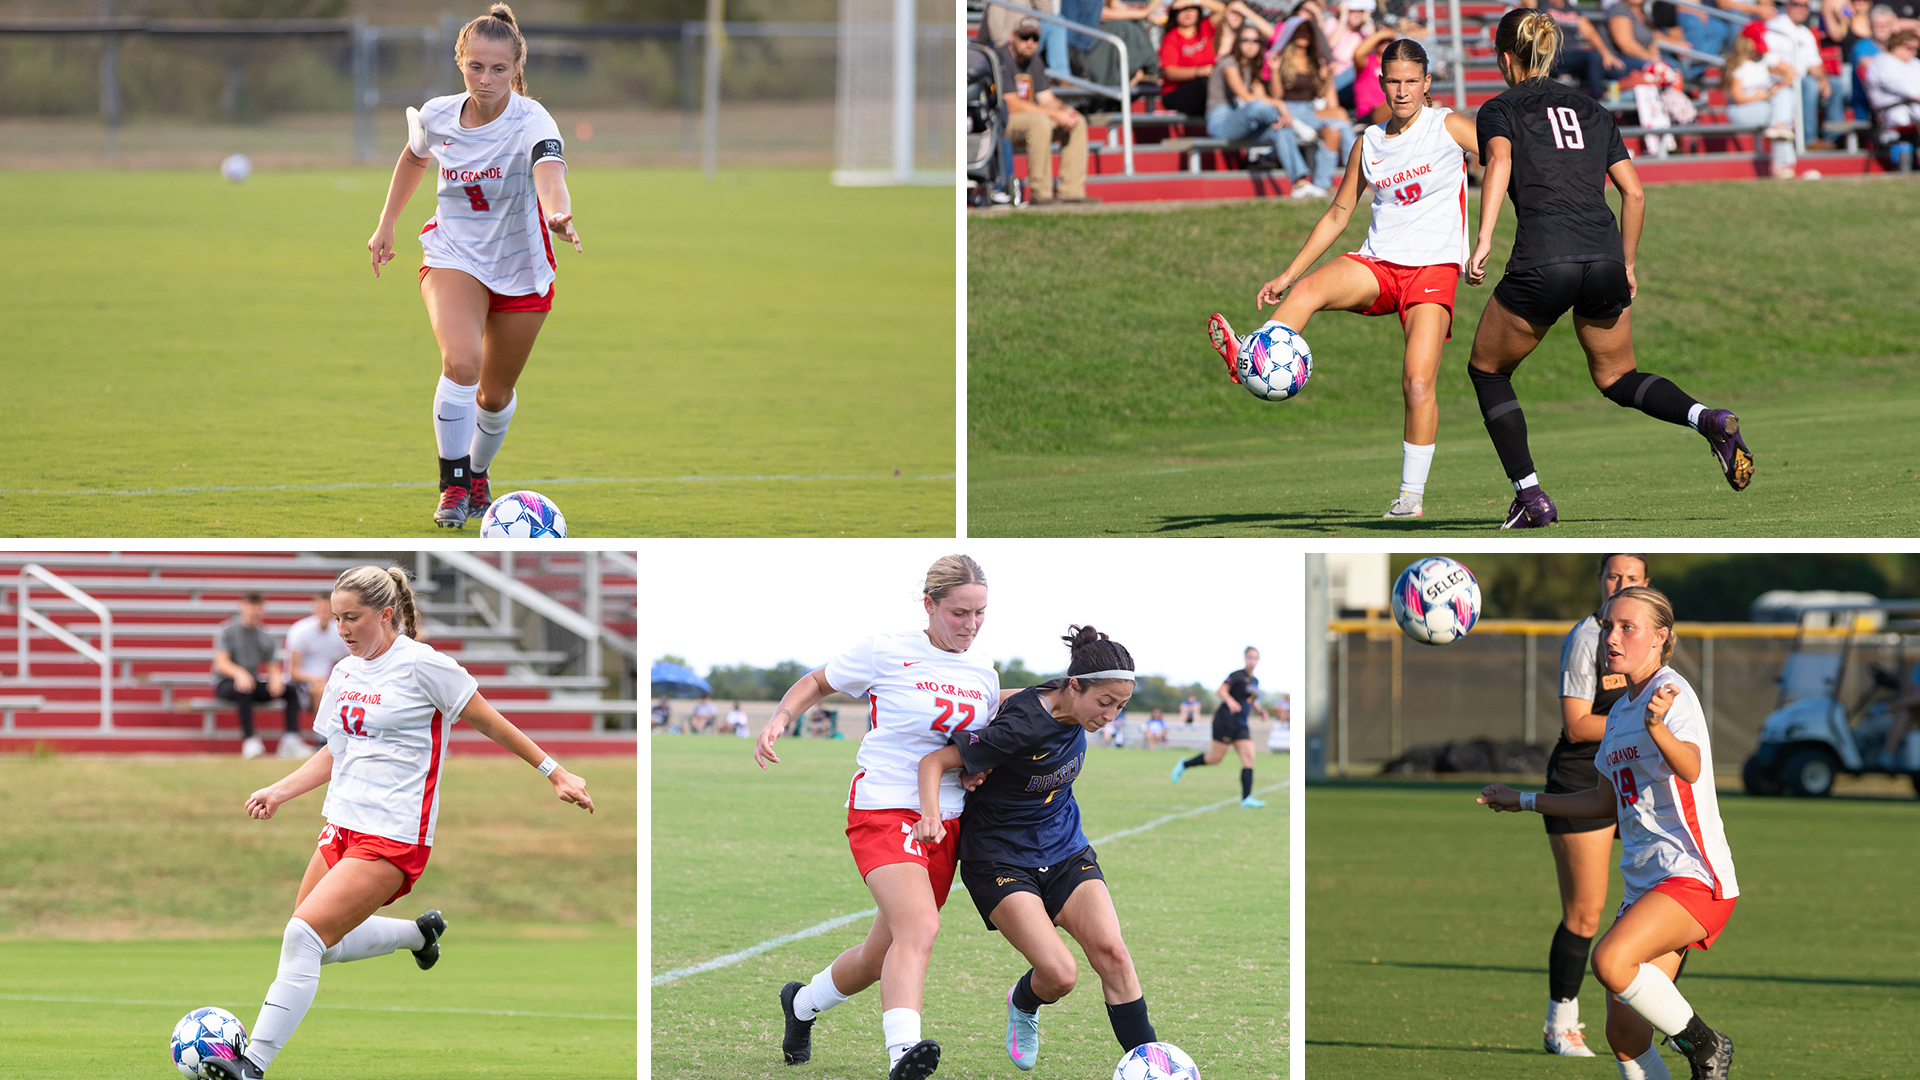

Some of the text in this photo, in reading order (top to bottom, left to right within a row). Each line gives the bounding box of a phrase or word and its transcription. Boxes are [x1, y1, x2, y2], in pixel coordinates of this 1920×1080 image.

[1546, 106, 1585, 150] 19
[441, 167, 502, 182] RIO GRANDE
[1375, 163, 1432, 191] RIO GRANDE
[463, 184, 490, 212] 8
[1426, 569, 1469, 601] SELECT
[347, 691, 381, 705] GRANDE
[915, 681, 983, 701] RIO GRANDE
[339, 704, 368, 737] 12
[929, 695, 976, 734] 22
[1611, 745, 1641, 765] GRANDE
[1612, 766, 1640, 810] 19
